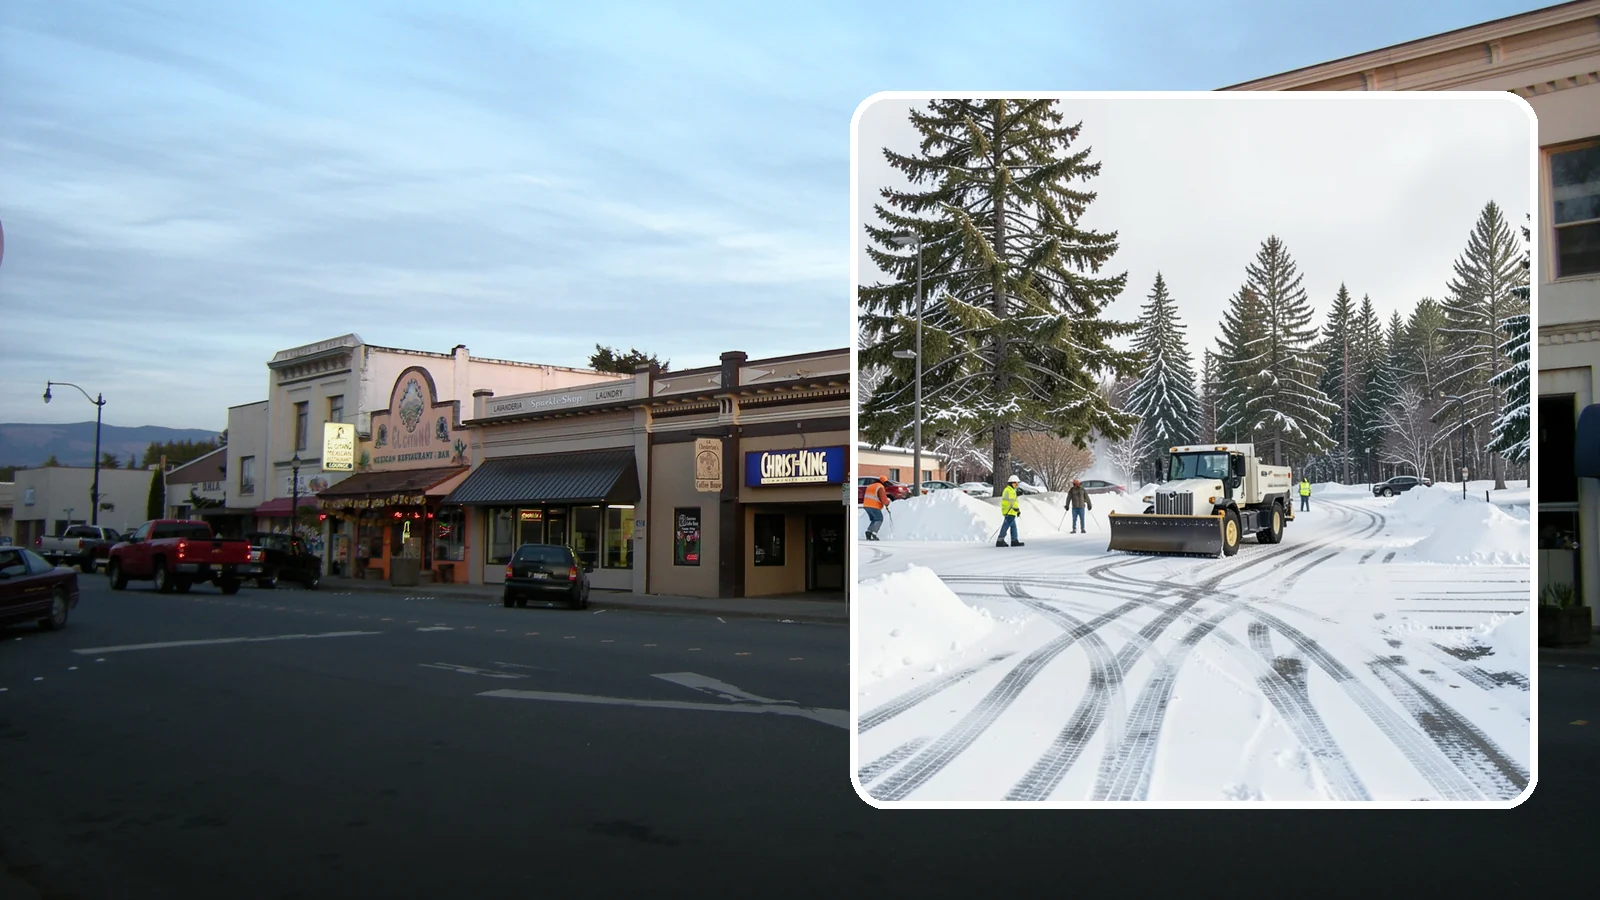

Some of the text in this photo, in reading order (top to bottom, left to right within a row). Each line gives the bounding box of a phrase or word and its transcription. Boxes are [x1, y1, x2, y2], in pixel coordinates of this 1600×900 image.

[493, 388, 623, 412] LAVANDERIA Sparkle Shop LAUNDRY
[373, 450, 450, 464] MEXICAN RESTAURANT BAR
[760, 450, 827, 478] CHRIST KING
